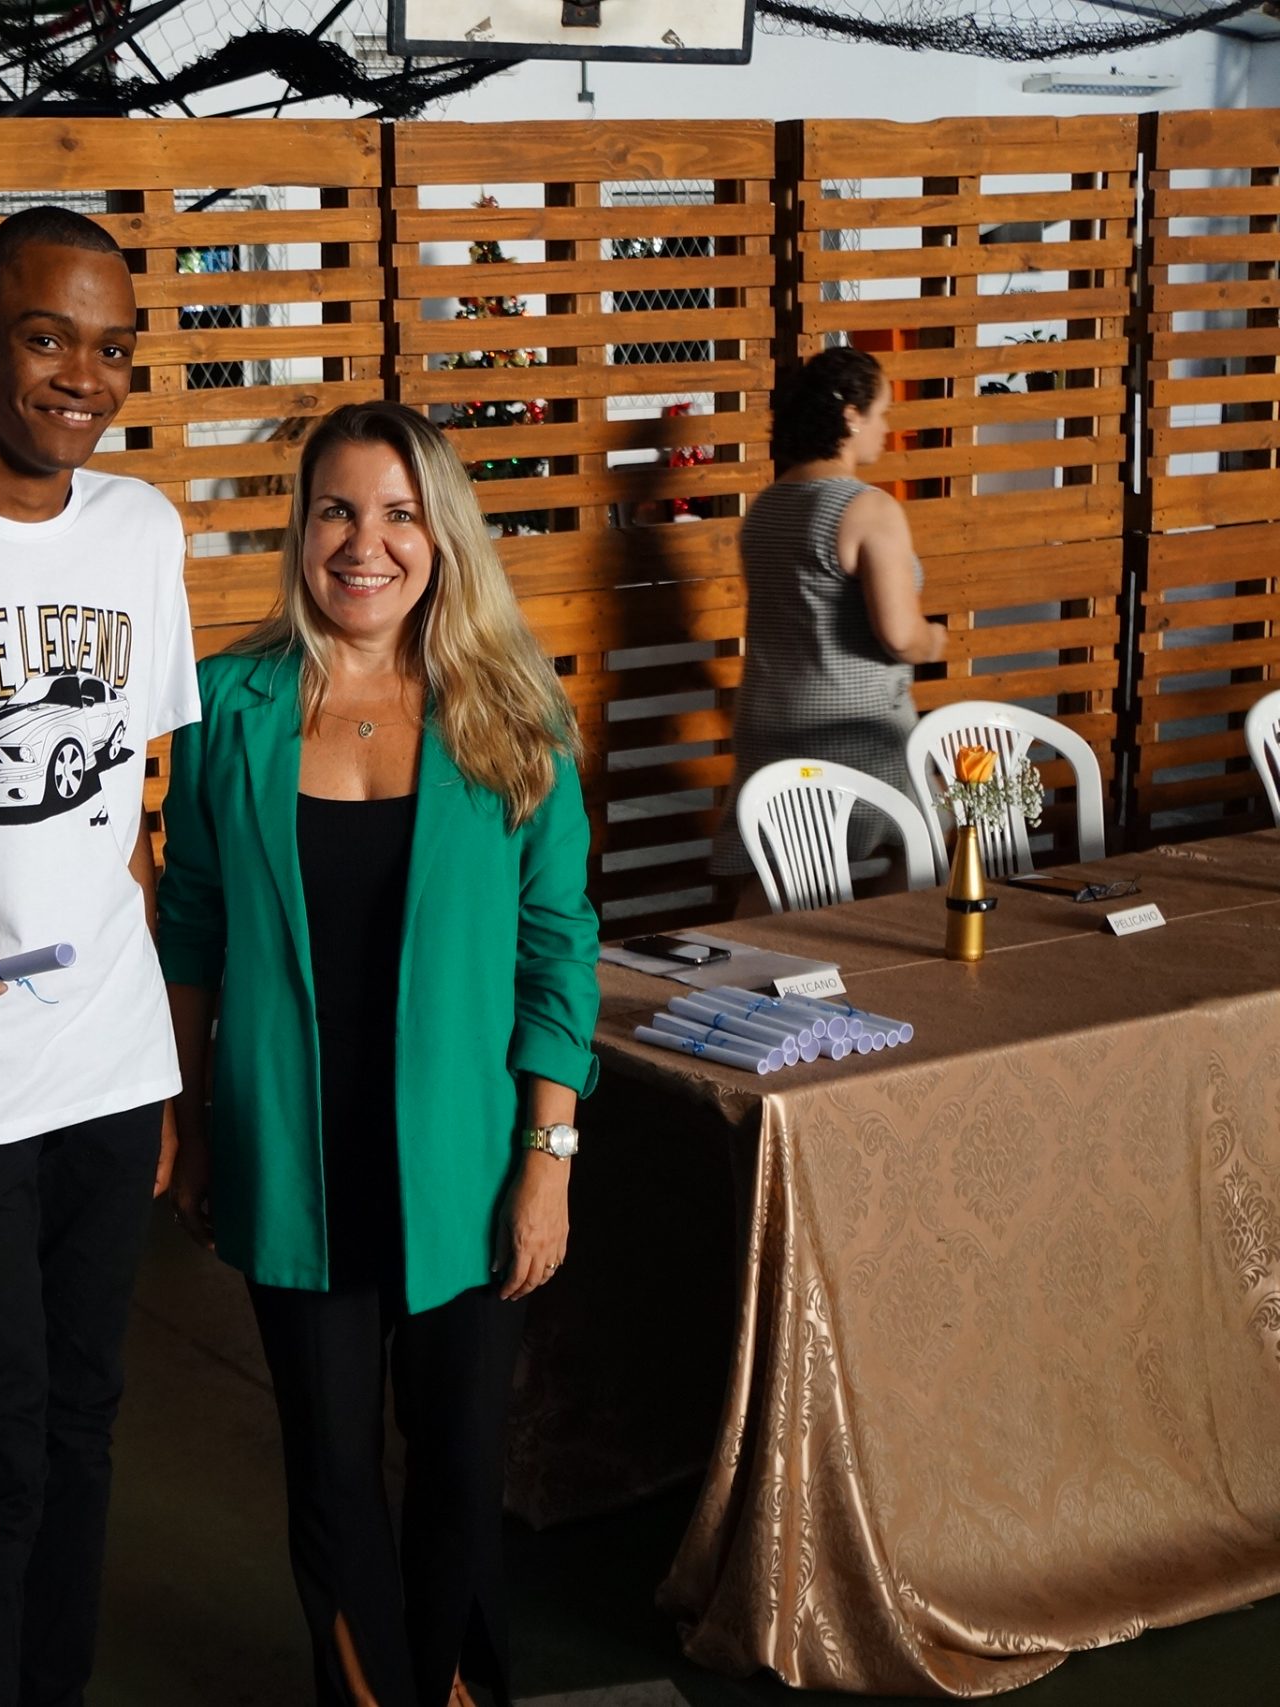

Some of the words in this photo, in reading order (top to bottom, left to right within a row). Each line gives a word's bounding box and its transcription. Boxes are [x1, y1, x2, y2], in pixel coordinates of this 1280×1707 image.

[16, 604, 132, 690] LEGEND
[1113, 911, 1159, 929] PELICANO
[782, 978, 838, 995] PELICANO
